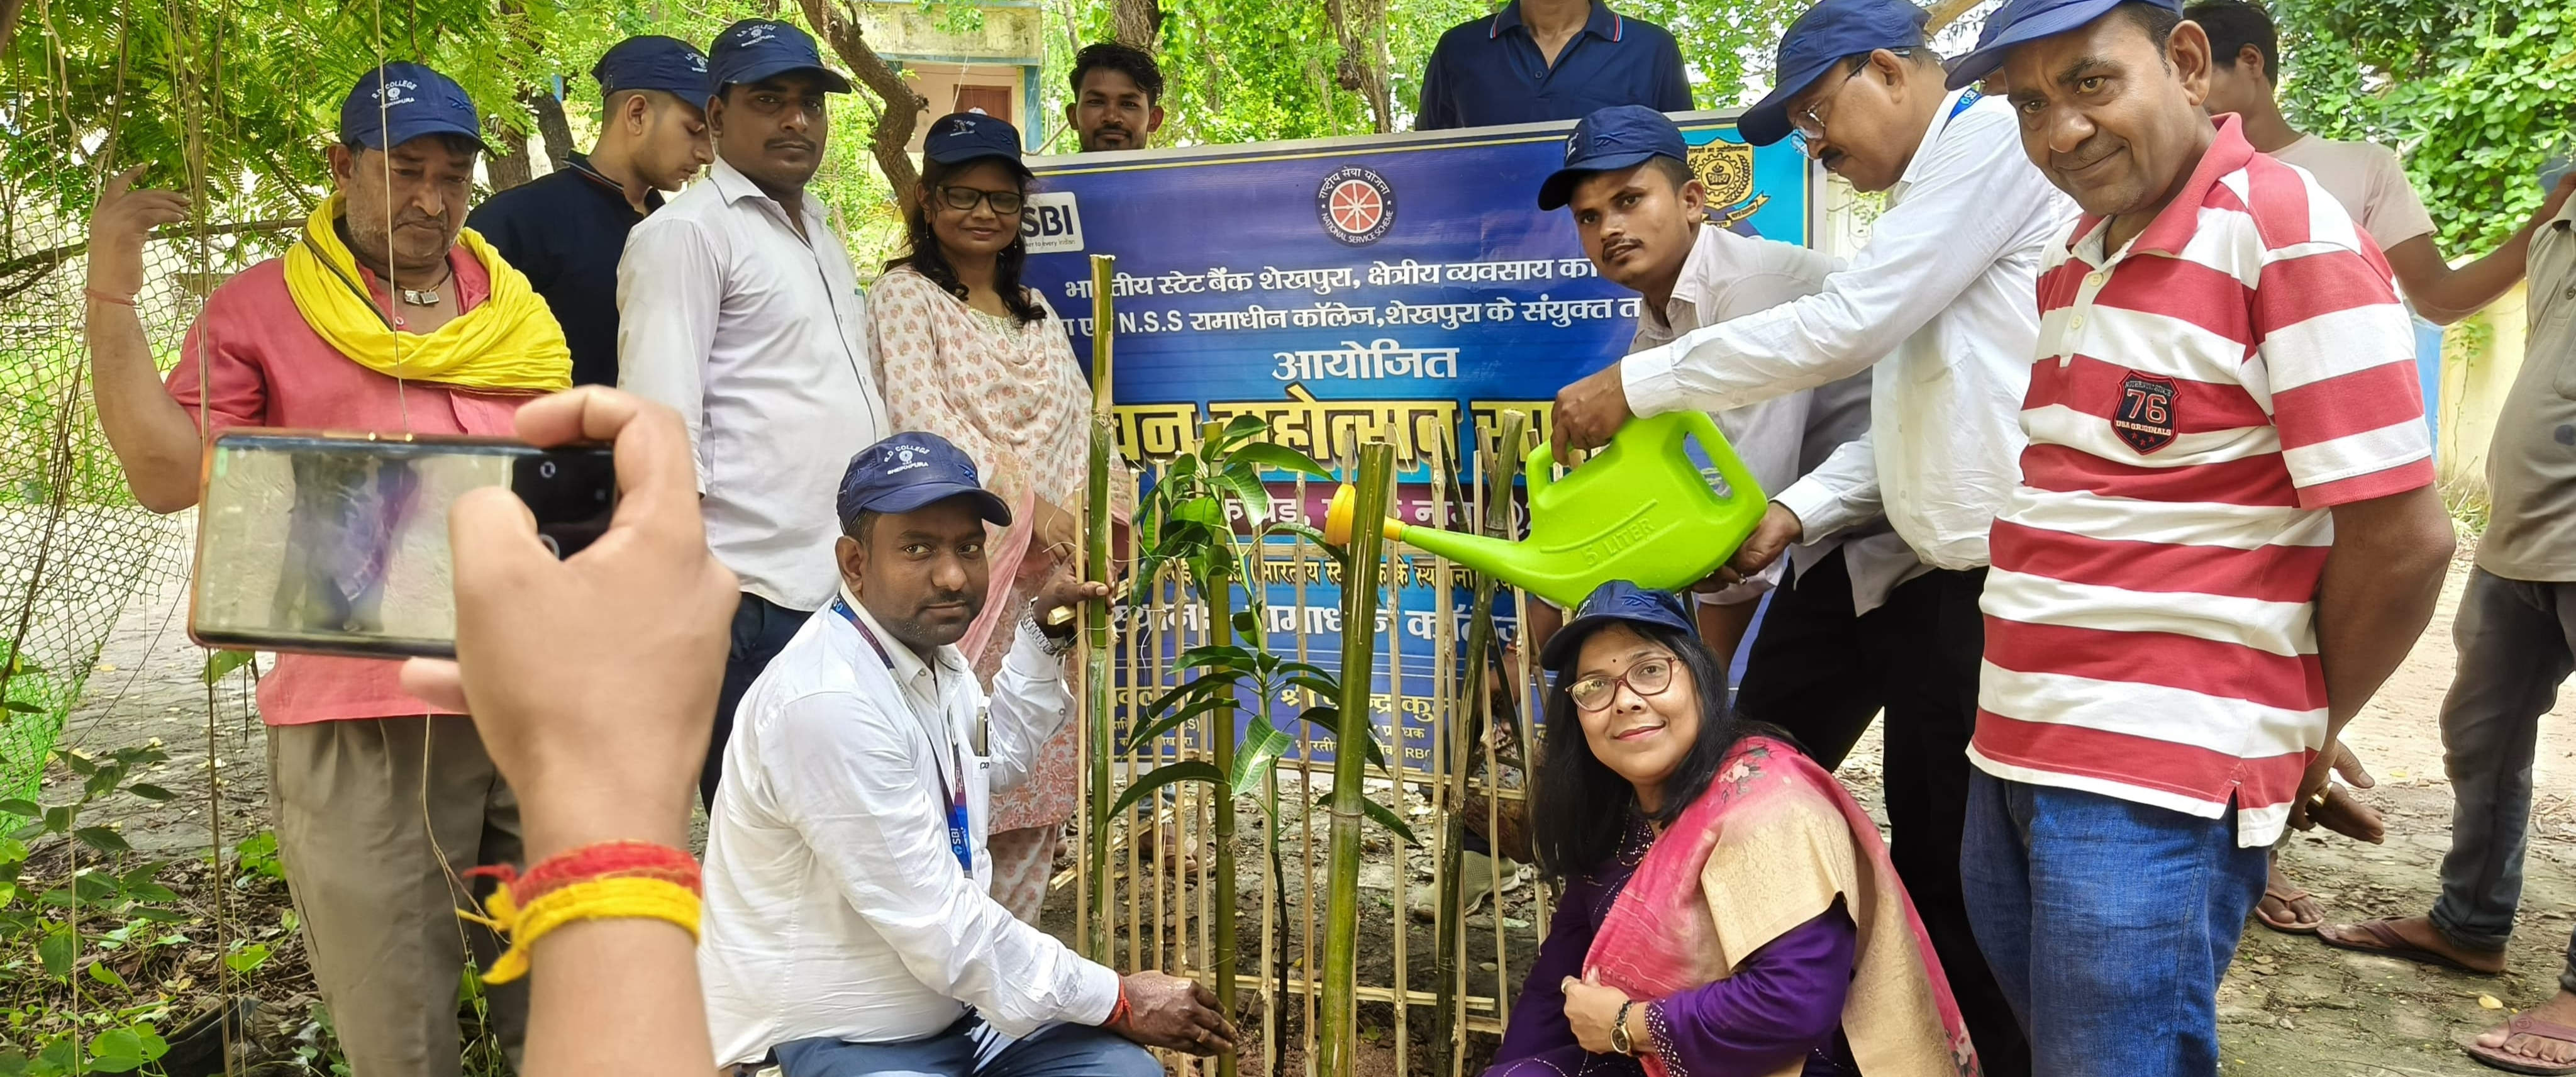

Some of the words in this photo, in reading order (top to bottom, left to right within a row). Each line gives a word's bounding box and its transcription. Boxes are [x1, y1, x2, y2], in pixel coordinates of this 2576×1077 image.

[385, 80, 417, 90] COLLEGE
[1341, 166, 1362, 177] सेवा
[1364, 169, 1391, 194] योजना
[1021, 205, 1074, 237] SBI
[1321, 213, 1346, 241] NATIONAL
[1348, 233, 1376, 243] SERVICE
[1374, 209, 1394, 235] SCHEME
[1065, 272, 1153, 298] भातीय
[1157, 271, 1206, 294] स्टेट
[1208, 266, 1253, 292] बैंक
[1259, 265, 1360, 294] शेखपुरा,
[1368, 260, 1441, 286] क्षेत्रीय
[1445, 260, 1555, 283] व्यवसाय
[1119, 310, 1183, 333] N.S.S
[1189, 304, 1289, 331] रामाधीन
[1485, 297, 1515, 322] के
[1522, 293, 1613, 328] संयुक्त
[1272, 338, 1460, 381] आयोजित
[2127, 388, 2167, 423] 76
[2116, 420, 2130, 429] USA
[2131, 423, 2171, 436] ORIGINALS
[895, 445, 930, 454] COLLEGE
[1580, 544, 1599, 566] 5
[1604, 518, 1656, 557] LITER
[950, 828, 961, 844] SBI
